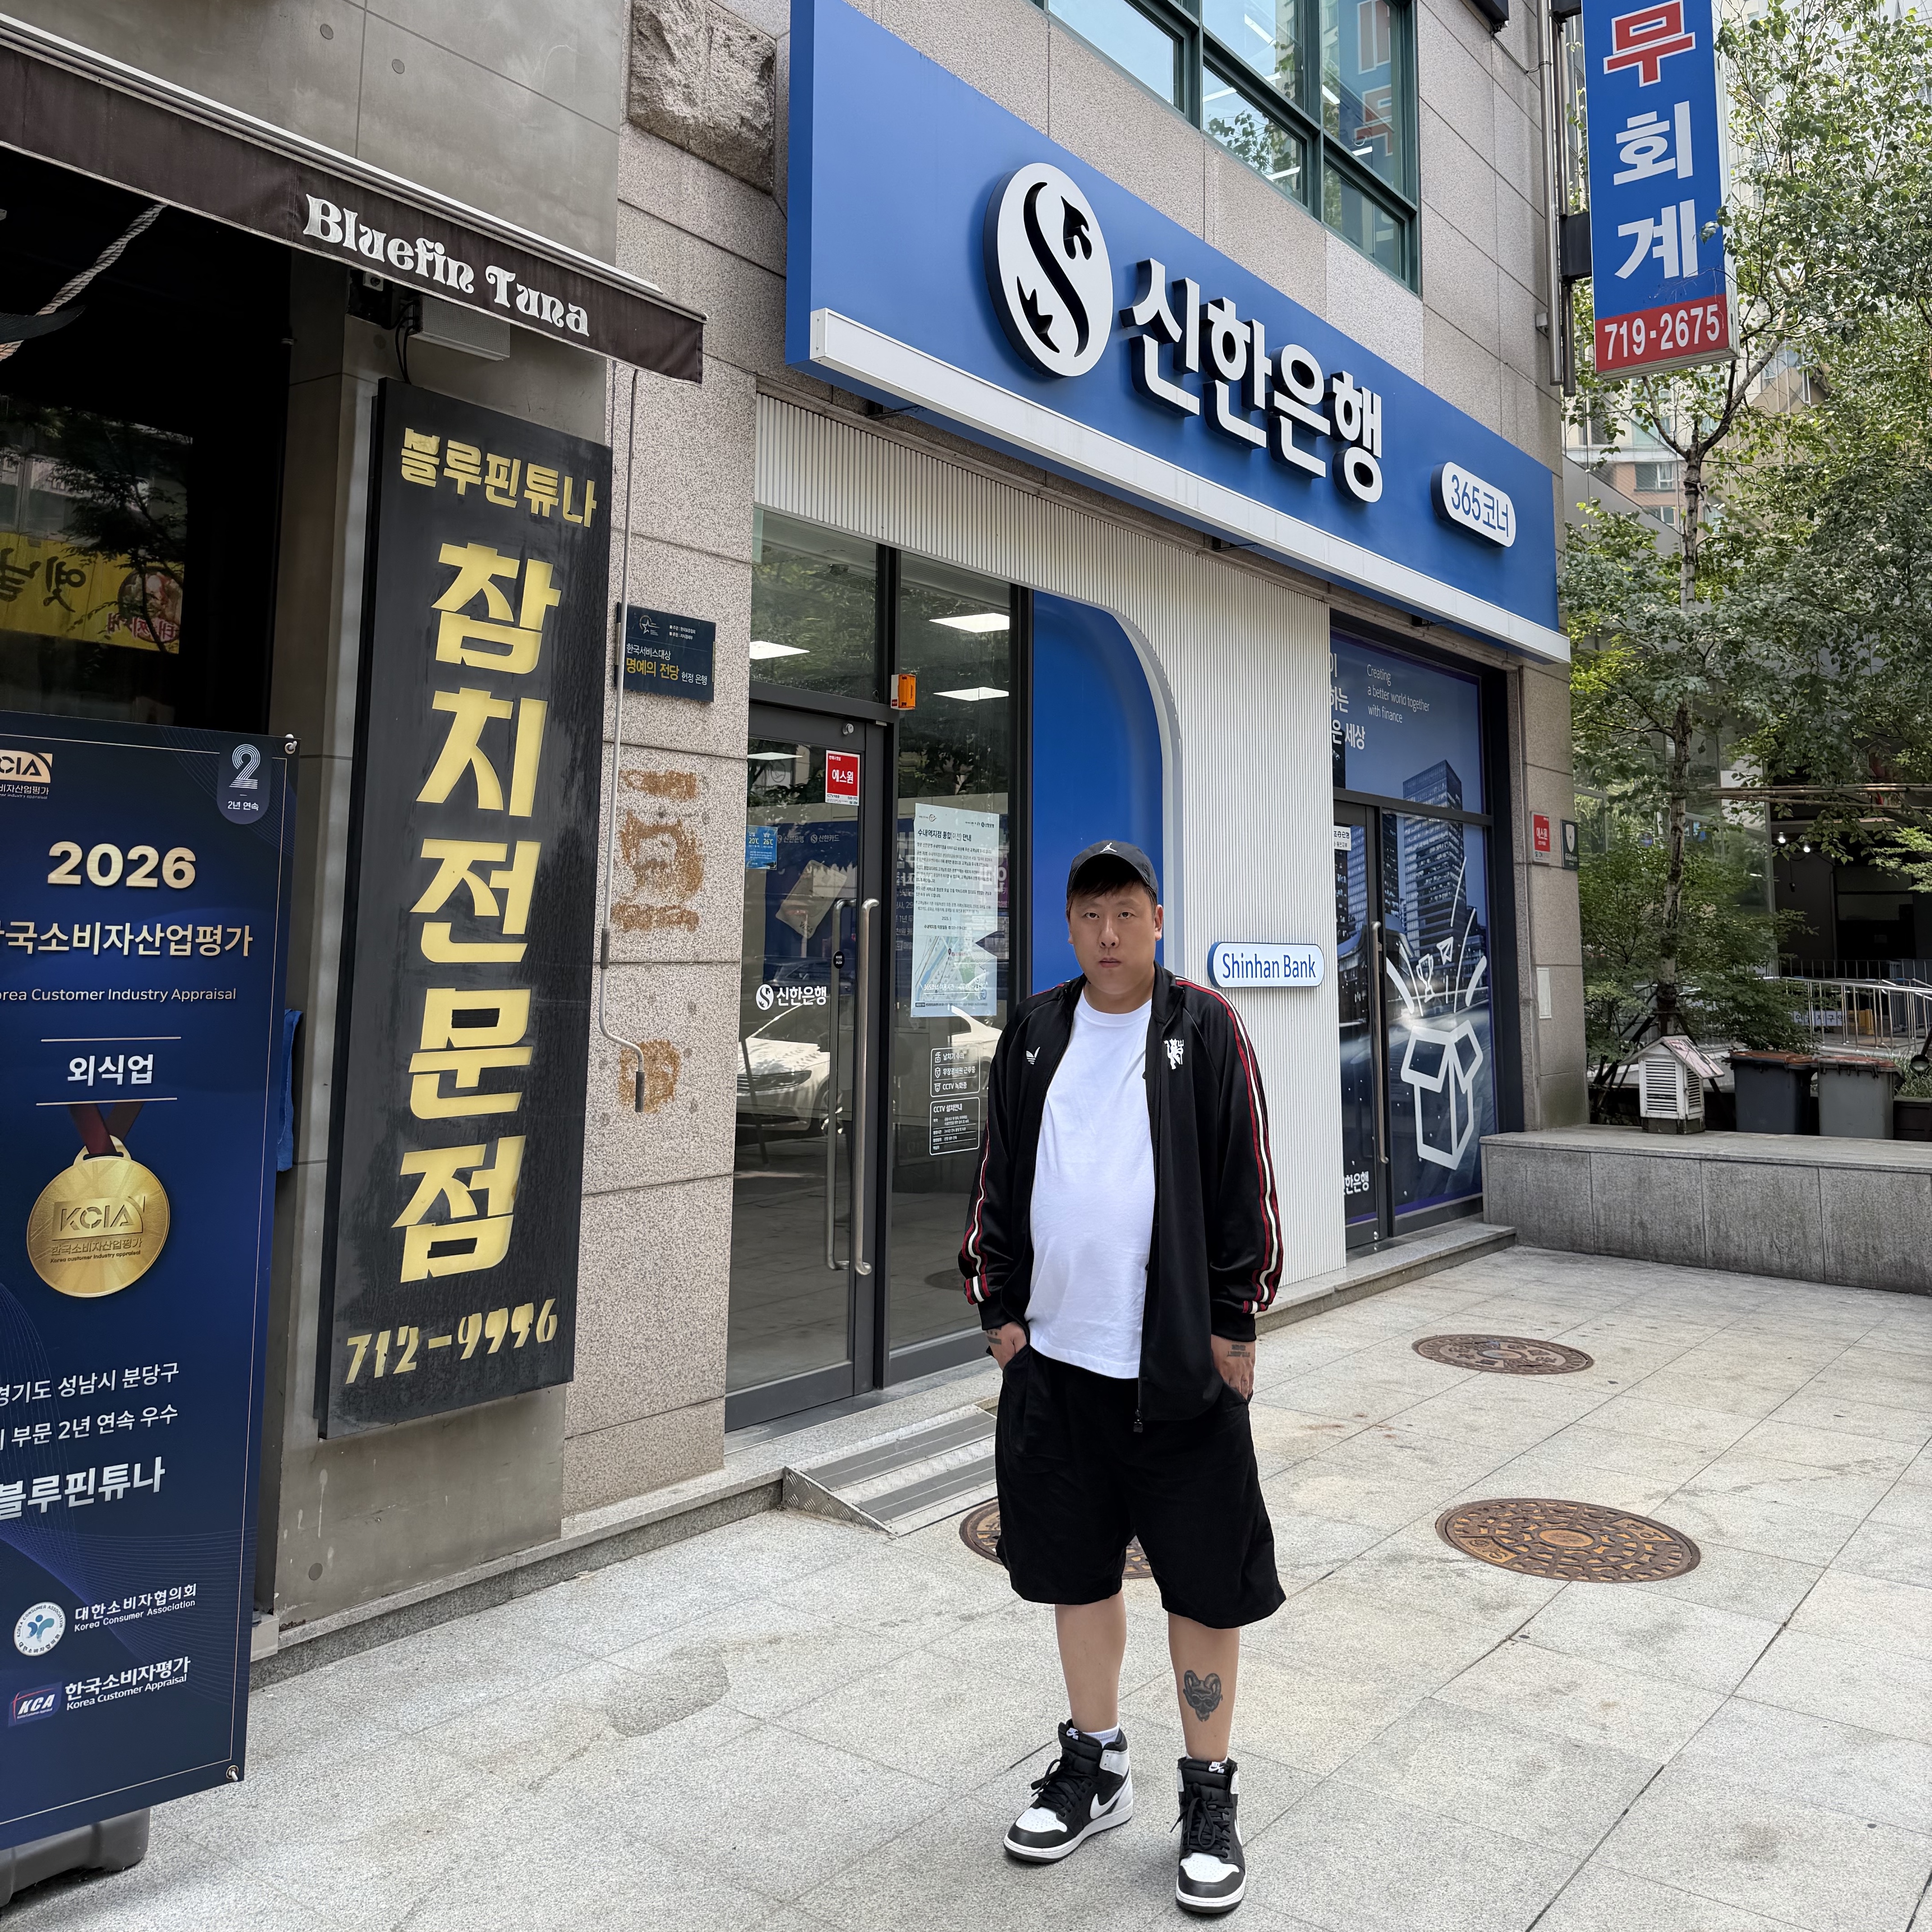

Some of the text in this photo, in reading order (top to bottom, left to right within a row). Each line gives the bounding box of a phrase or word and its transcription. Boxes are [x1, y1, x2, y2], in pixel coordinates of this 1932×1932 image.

[303, 194, 589, 337] Bluefin Tuna
[1605, 305, 1720, 360] 719-2675
[1123, 258, 1382, 503] 신한은행
[401, 427, 597, 528] 블루핀튜나
[1451, 474, 1509, 537] 365코너
[626, 643, 671, 661] 한국서비스대상
[626, 657, 708, 685] 명예의 전당 헌정 은행
[1367, 664, 1392, 686] Creating
[1367, 684, 1430, 712] a better world together
[1368, 704, 1403, 723] with finance
[1345, 723, 1366, 750] 세상
[227, 801, 259, 811] 2년 연속
[47, 841, 196, 889] 2026
[391, 543, 561, 1283] 참치전문점
[0, 920, 253, 957] 국소비자산업평가
[1223, 953, 1316, 979] Shinhan Bank
[31, 988, 105, 1000] Customer
[108, 988, 168, 1002] Industry
[171, 987, 236, 1002] Appraisal
[777, 986, 827, 1006] 신한은행
[68, 1054, 154, 1086] 외식업
[1343, 1170, 1369, 1195] 한은행
[60, 1204, 135, 1232] KCIA
[51, 1238, 143, 1256] 한국소비자산업평가
[345, 1299, 557, 1384] 712-9996
[58, 1370, 116, 1397] 성남시
[122, 1362, 179, 1389] 분당구
[11, 1404, 178, 1448] 부문 2년 연속 우수
[0, 1456, 165, 1520] 블루핀튜나
[74, 1600, 196, 1632] Korea Consumer Association
[75, 1583, 197, 1620] 대한소비자협의회
[65, 1656, 191, 1701] 한국소비자평가
[67, 1673, 187, 1711] Korea Customer Appraisal
[18, 1694, 55, 1715] KCA
